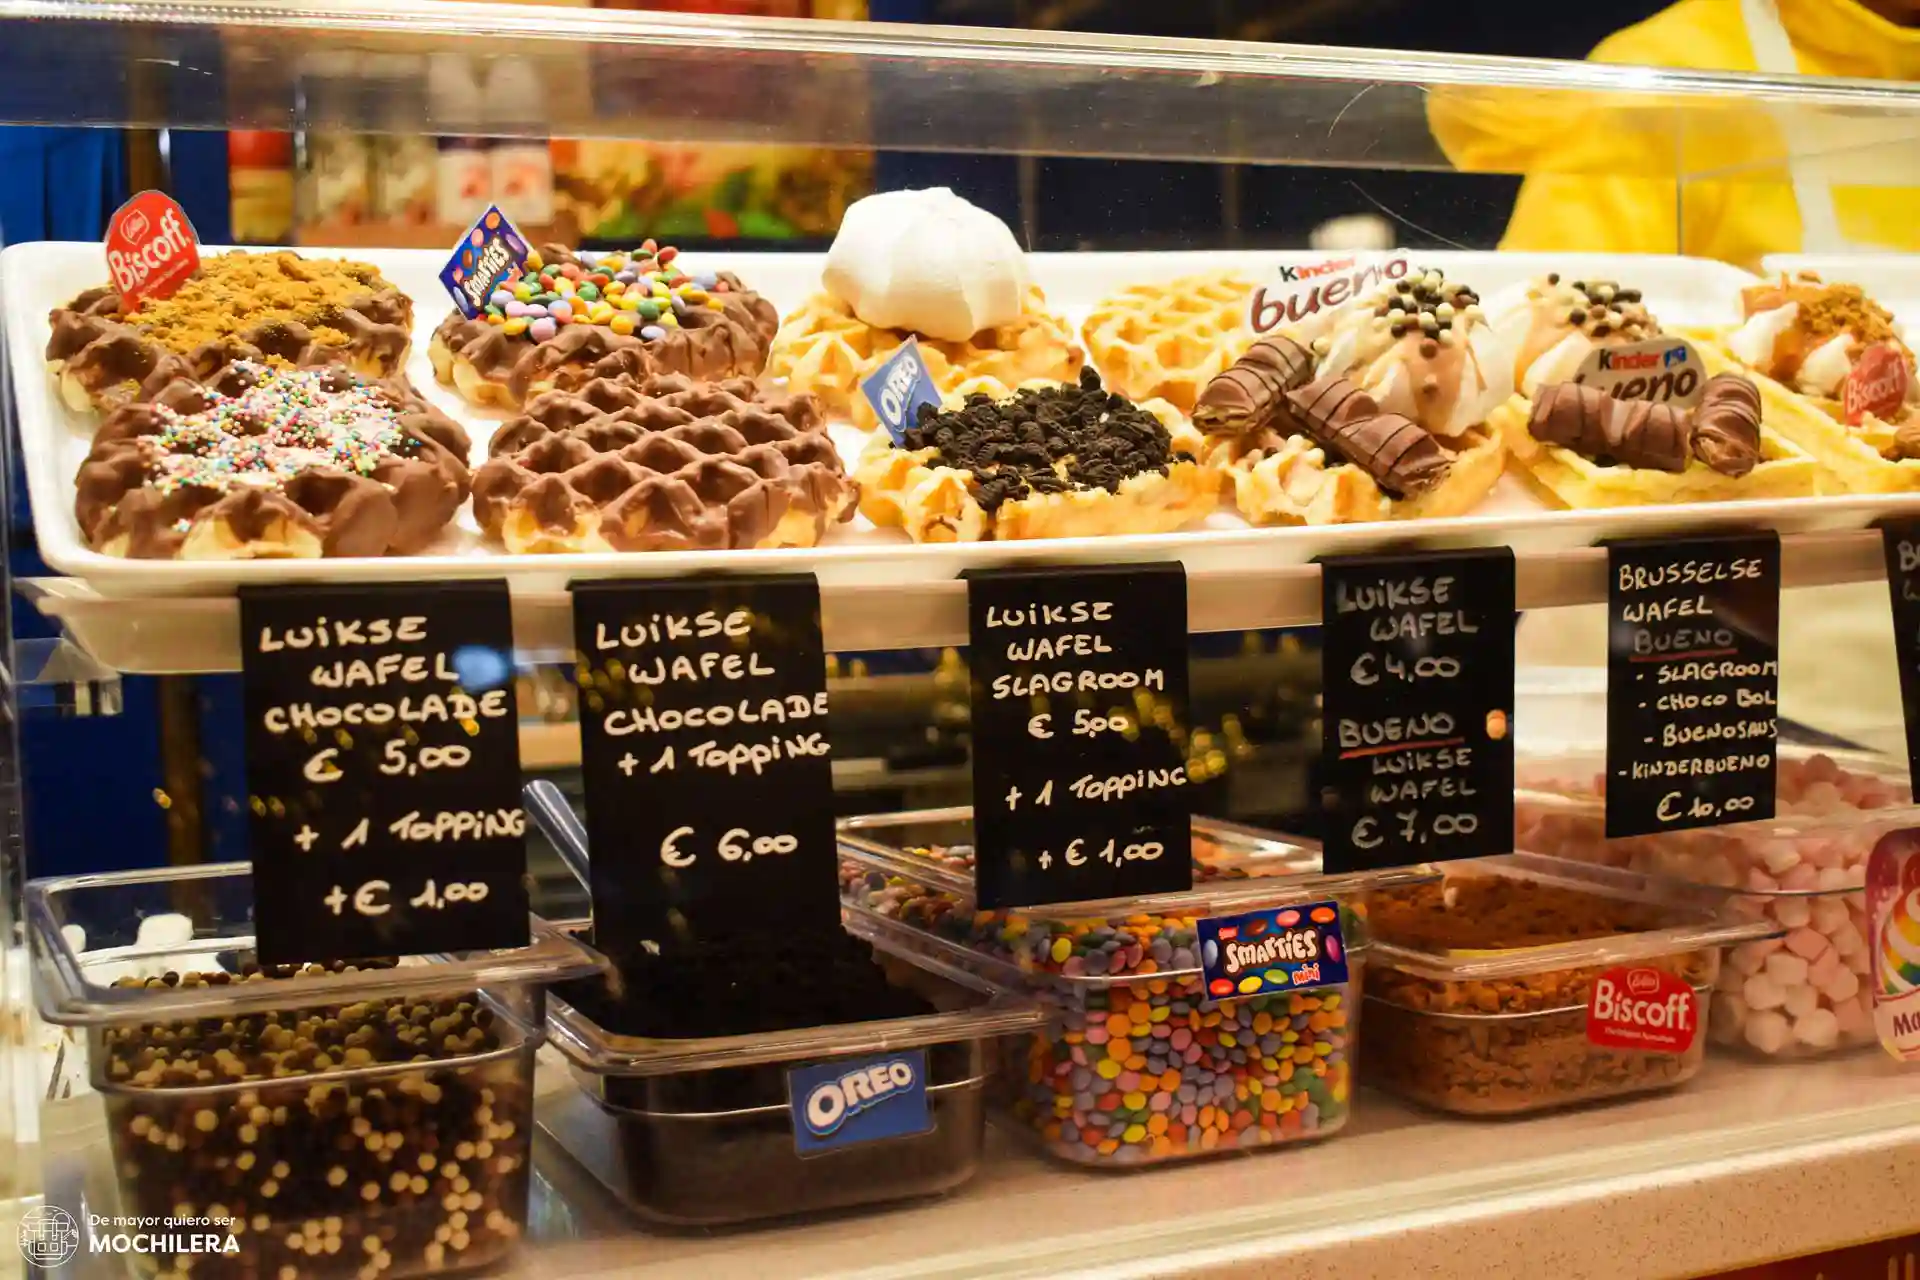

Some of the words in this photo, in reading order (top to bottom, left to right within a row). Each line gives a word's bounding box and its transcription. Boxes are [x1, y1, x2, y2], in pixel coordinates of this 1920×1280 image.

[108, 207, 190, 293] Biscoff
[1250, 259, 1408, 333] bueno
[1598, 348, 1660, 371] Kinder
[881, 355, 918, 426] OREO
[1618, 558, 1763, 592] BRUSSELSE
[1622, 595, 1714, 624] WAFEL
[1369, 609, 1480, 643] WAFEL
[1633, 628, 1735, 655] BUENO
[1006, 634, 1113, 662] WAFEL
[309, 652, 460, 688] WAFEL
[628, 652, 776, 685] WAFEL
[991, 668, 1165, 700] SLAGROOM
[1350, 652, 1380, 686] €
[1385, 653, 1461, 683] 4,00
[1657, 660, 1778, 685] SLAGROOM
[263, 689, 507, 733] CHOCOLADE
[603, 692, 829, 736] CHOCOLADE
[1656, 692, 1728, 711] CHOCO
[1736, 688, 1777, 708] BOL
[1027, 713, 1055, 739] €
[1338, 712, 1456, 749] BUENO
[303, 748, 344, 782] €
[379, 738, 471, 776] 5,00
[649, 746, 675, 774] 1
[1035, 780, 1054, 806] 1
[1369, 779, 1477, 804] WAFEL
[1656, 790, 1684, 822] €
[1686, 794, 1756, 819] 10,00
[340, 818, 370, 849] 1
[1351, 816, 1384, 850] €
[1396, 809, 1479, 844] 7,00
[660, 825, 697, 868] €
[717, 827, 798, 862] 6,00
[1065, 838, 1088, 867] €
[1098, 839, 1165, 868] 1,00
[409, 879, 489, 909] 1,00
[1292, 962, 1321, 985] mini
[1594, 978, 1692, 1030] Biscoff
[807, 1062, 912, 1128] OREO
